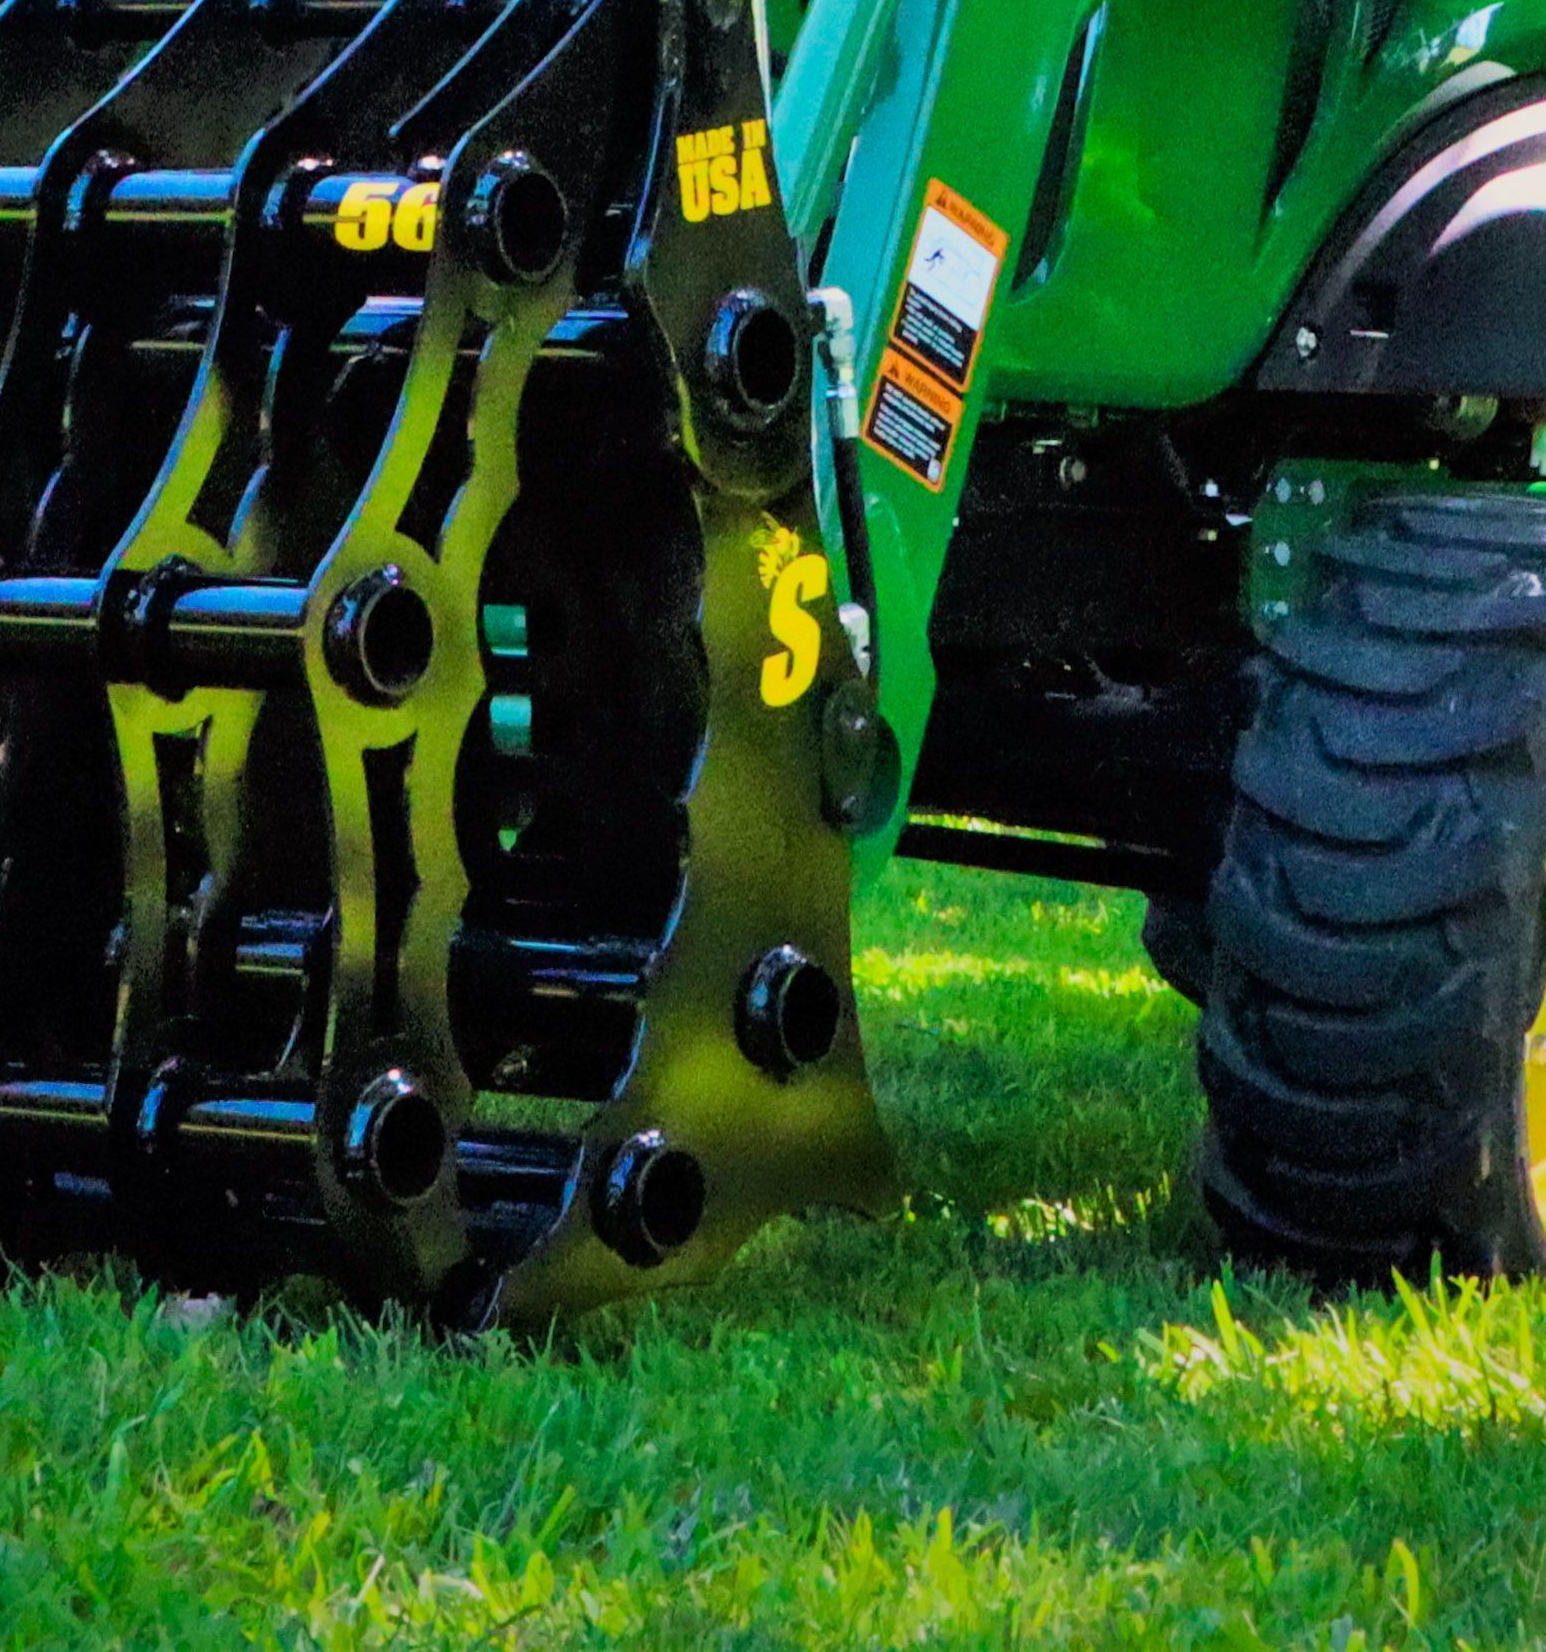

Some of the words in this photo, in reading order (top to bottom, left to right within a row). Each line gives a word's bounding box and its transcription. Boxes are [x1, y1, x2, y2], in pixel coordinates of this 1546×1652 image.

[676, 125, 735, 164] MADE
[741, 118, 766, 149] IN
[334, 182, 441, 251] 56
[678, 148, 772, 222] USA
[904, 372, 951, 415] WARNING
[760, 553, 828, 707] S
